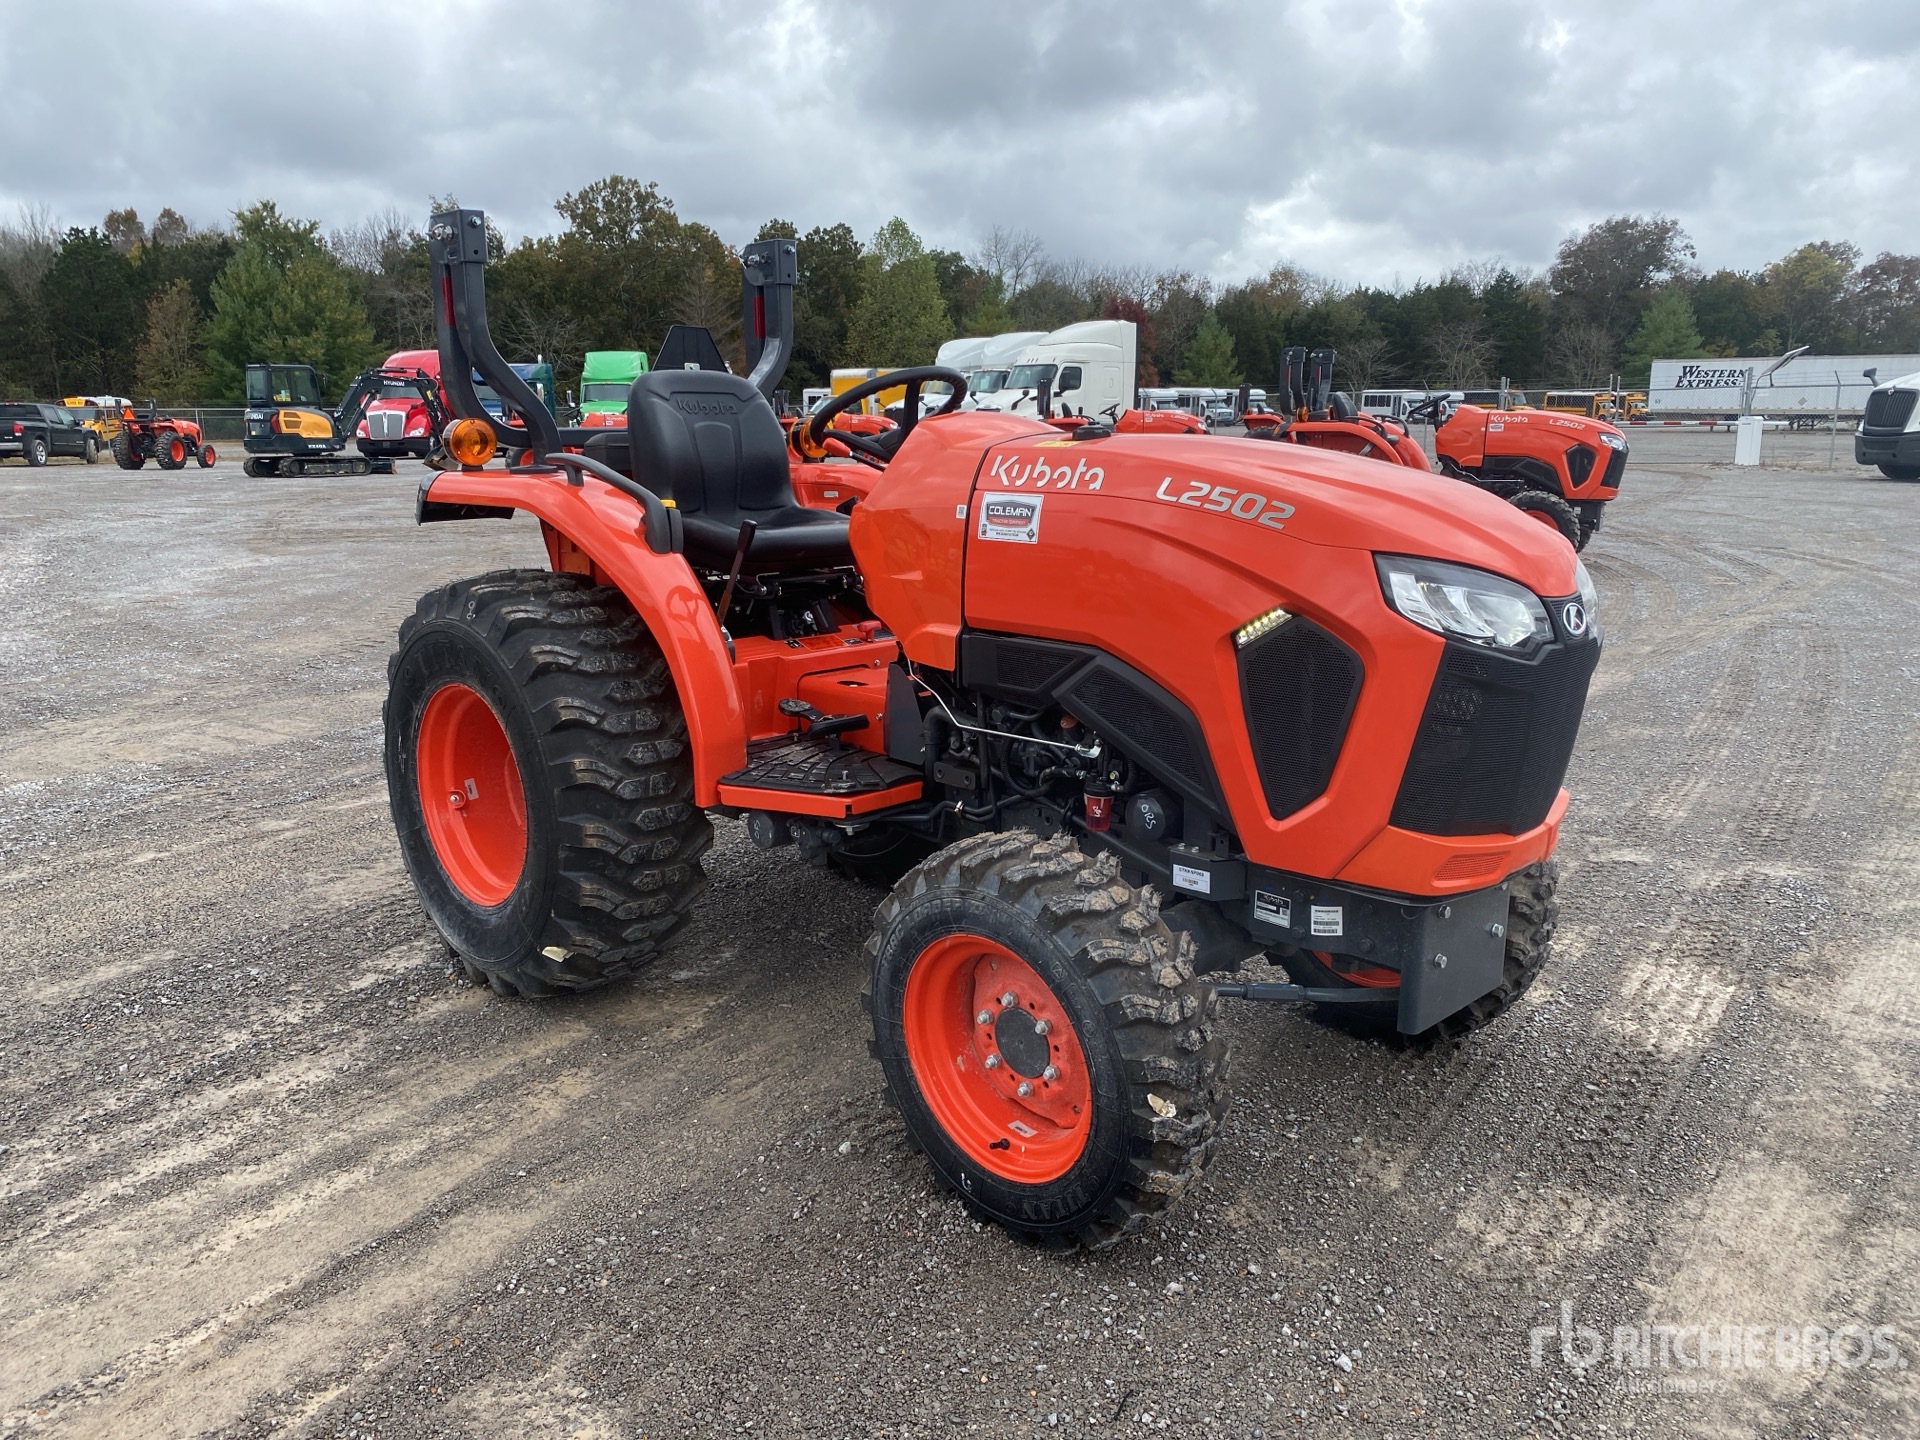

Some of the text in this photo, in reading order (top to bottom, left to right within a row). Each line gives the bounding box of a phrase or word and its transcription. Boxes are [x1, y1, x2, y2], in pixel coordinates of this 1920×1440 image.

[1681, 365, 1745, 379] WESTERN
[383, 379, 405, 387] HYUNDAI
[676, 399, 738, 415] Kubota
[1490, 414, 1586, 430] Kubota L2502
[989, 455, 1296, 531] Kubota L2502
[988, 505, 1032, 517] COLEMAN
